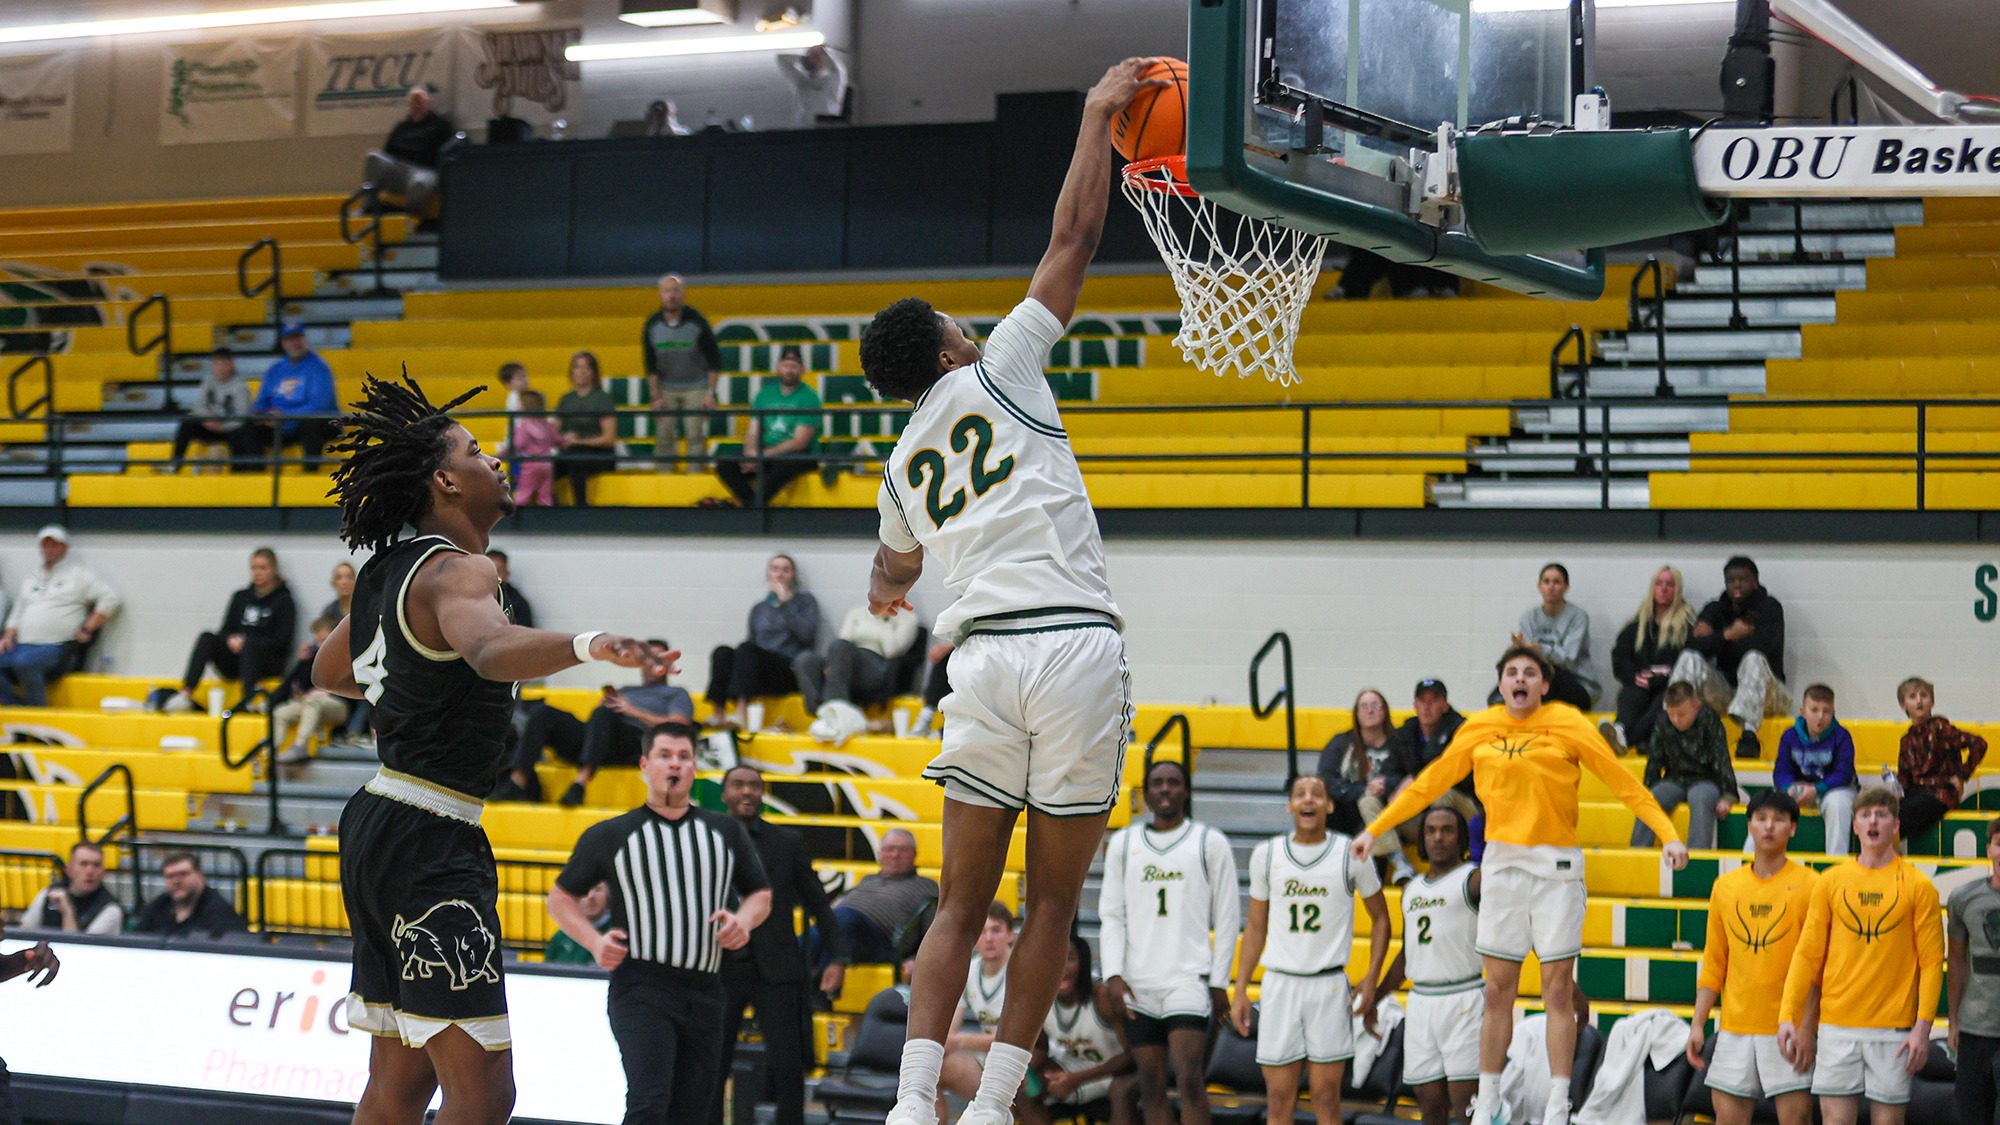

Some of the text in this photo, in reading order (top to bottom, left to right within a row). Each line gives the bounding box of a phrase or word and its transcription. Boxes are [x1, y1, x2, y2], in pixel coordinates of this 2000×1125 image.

[324, 51, 432, 91] TFCU
[1722, 136, 1856, 181] OBU
[906, 412, 1016, 532] 22
[352, 614, 389, 707] 4
[1141, 864, 1185, 883] Bison
[1282, 878, 1330, 898] Bison
[1157, 887, 1168, 917] 1
[1406, 895, 1447, 913] Bison
[1289, 903, 1322, 934] 12
[1417, 915, 1433, 945] 2
[405, 930, 419, 942] HU
